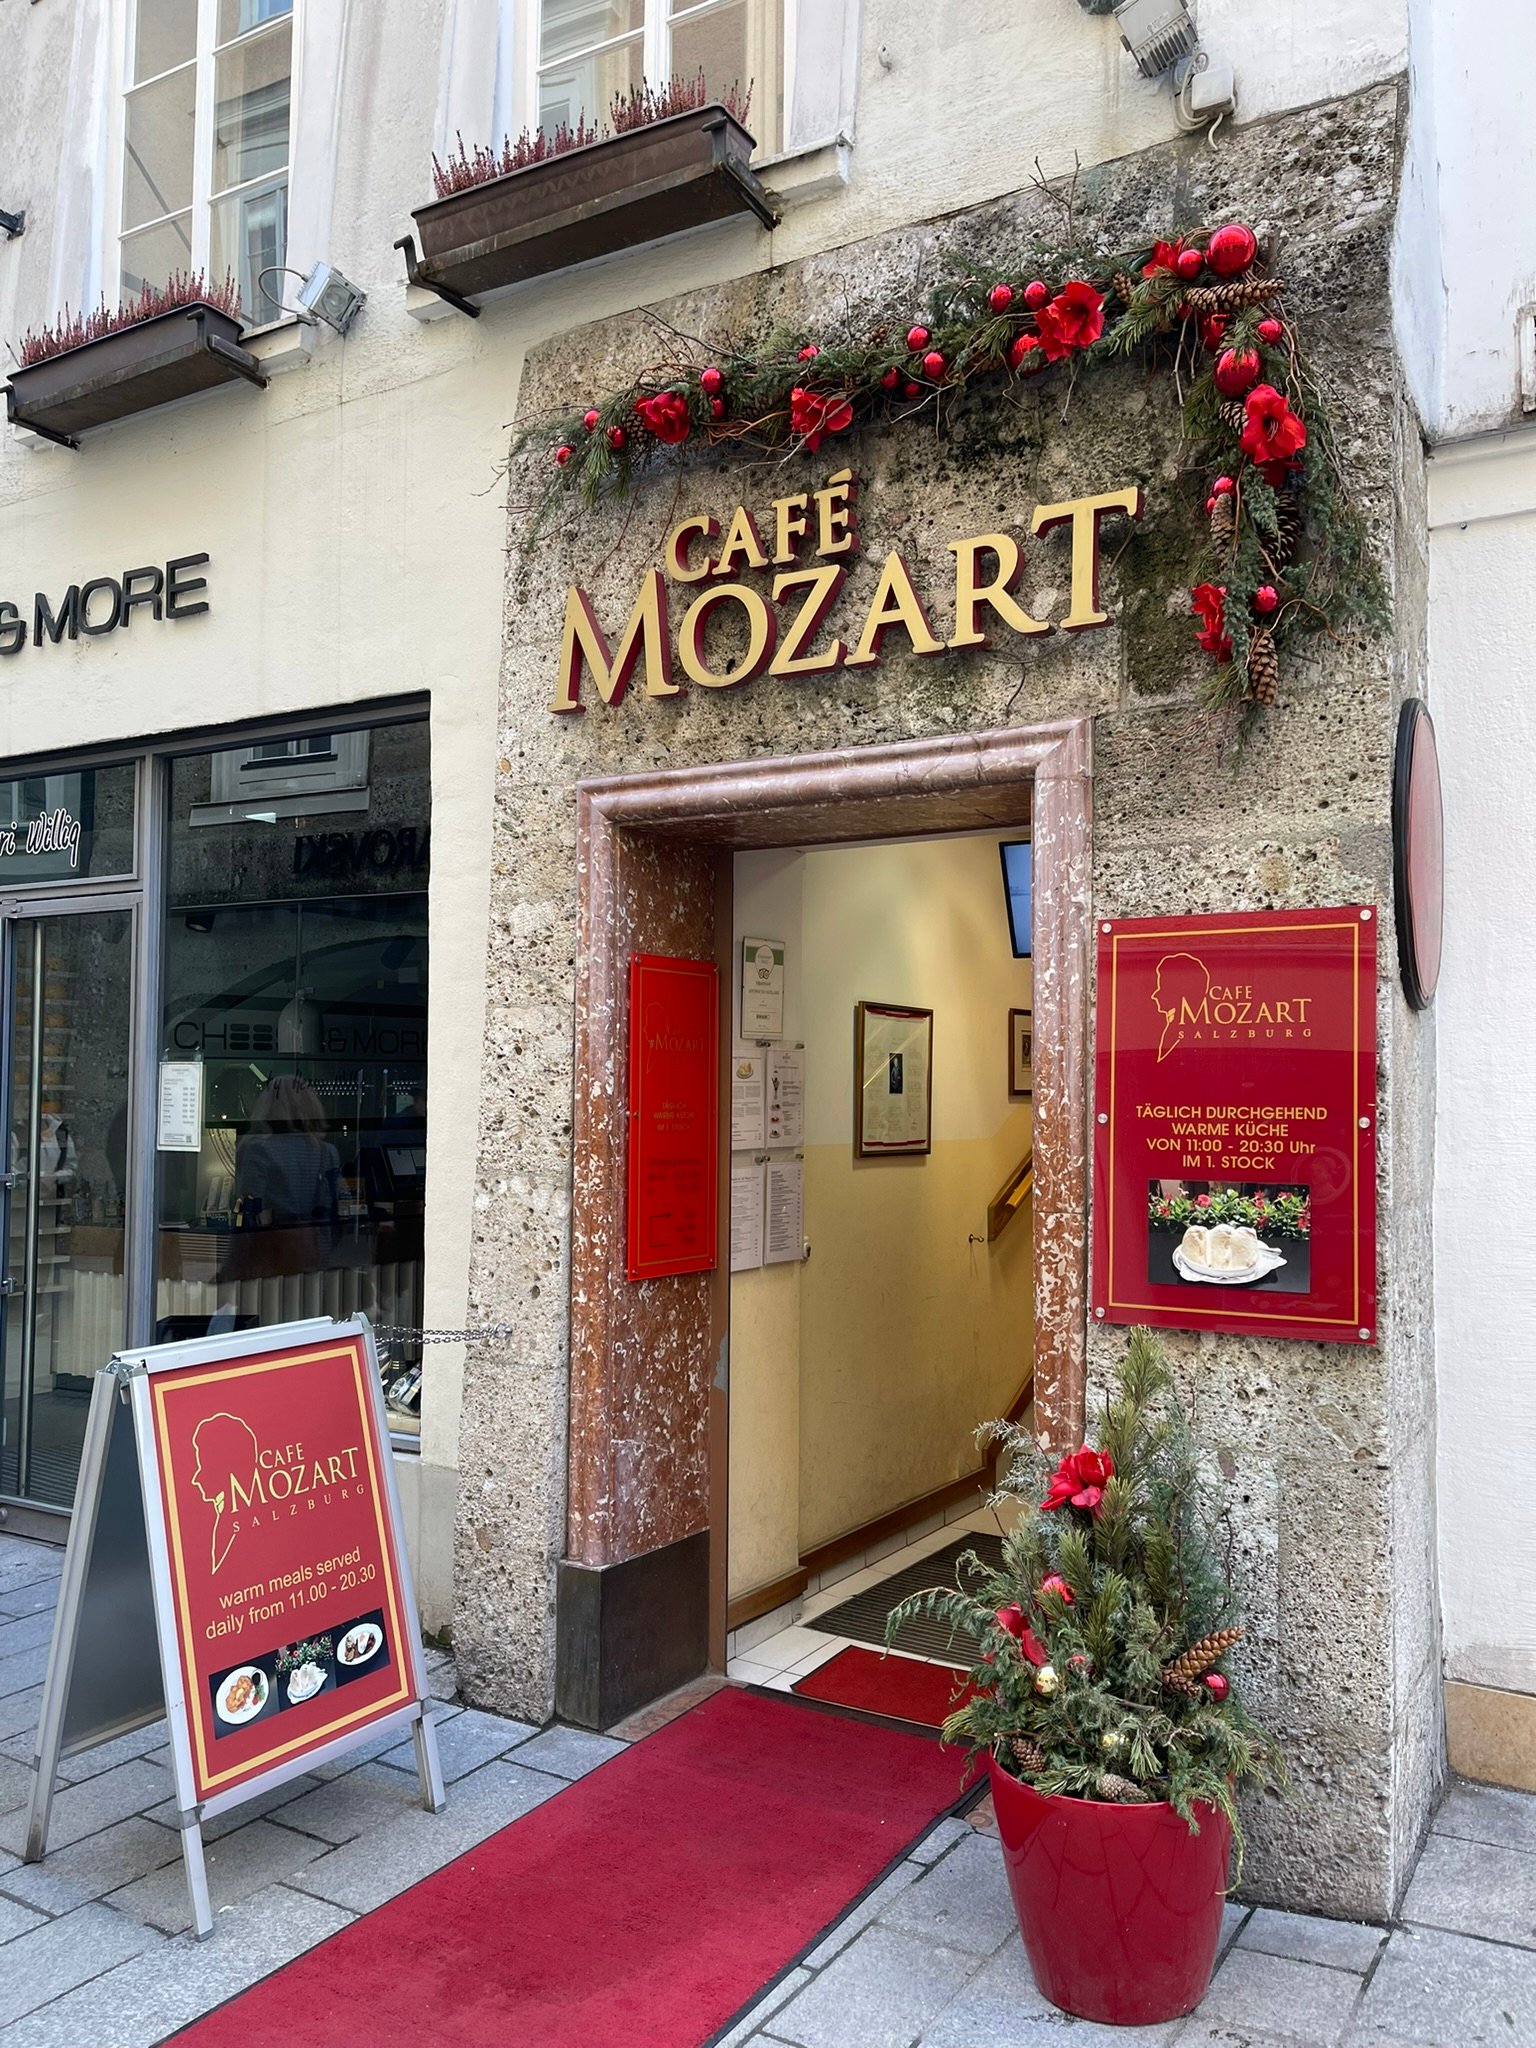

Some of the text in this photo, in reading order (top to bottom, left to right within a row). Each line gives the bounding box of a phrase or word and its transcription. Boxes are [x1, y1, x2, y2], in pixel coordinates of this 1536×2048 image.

[665, 467, 860, 585] CAFÉ
[33, 552, 210, 647] MORE
[547, 485, 1146, 717] MOZART
[26, 808, 81, 868] Willig
[1178, 996, 1313, 1026] MOZART
[1209, 985, 1253, 1001] CAFE
[1178, 1028, 1313, 1039] SALZBURG
[1136, 1103, 1328, 1121] TÄGLICH DURCHGEHEND
[1171, 1121, 1289, 1138] WARME KÜCHE
[1146, 1139, 1181, 1152] VON
[1187, 1139, 1222, 1152] 11:00
[1239, 1140, 1284, 1154] 20:30
[1290, 1141, 1316, 1155] Uhr
[1182, 1155, 1275, 1170] IM 1. STOCK
[259, 1442, 305, 1469] CAFE
[230, 1447, 359, 1513] MOZART
[233, 1484, 365, 1533] SALZBURG
[219, 1546, 361, 1609] warm meals served
[205, 1606, 245, 1640] daily
[248, 1598, 285, 1625] from
[289, 1582, 327, 1609] 11.00
[340, 1563, 376, 1592] 20.30
